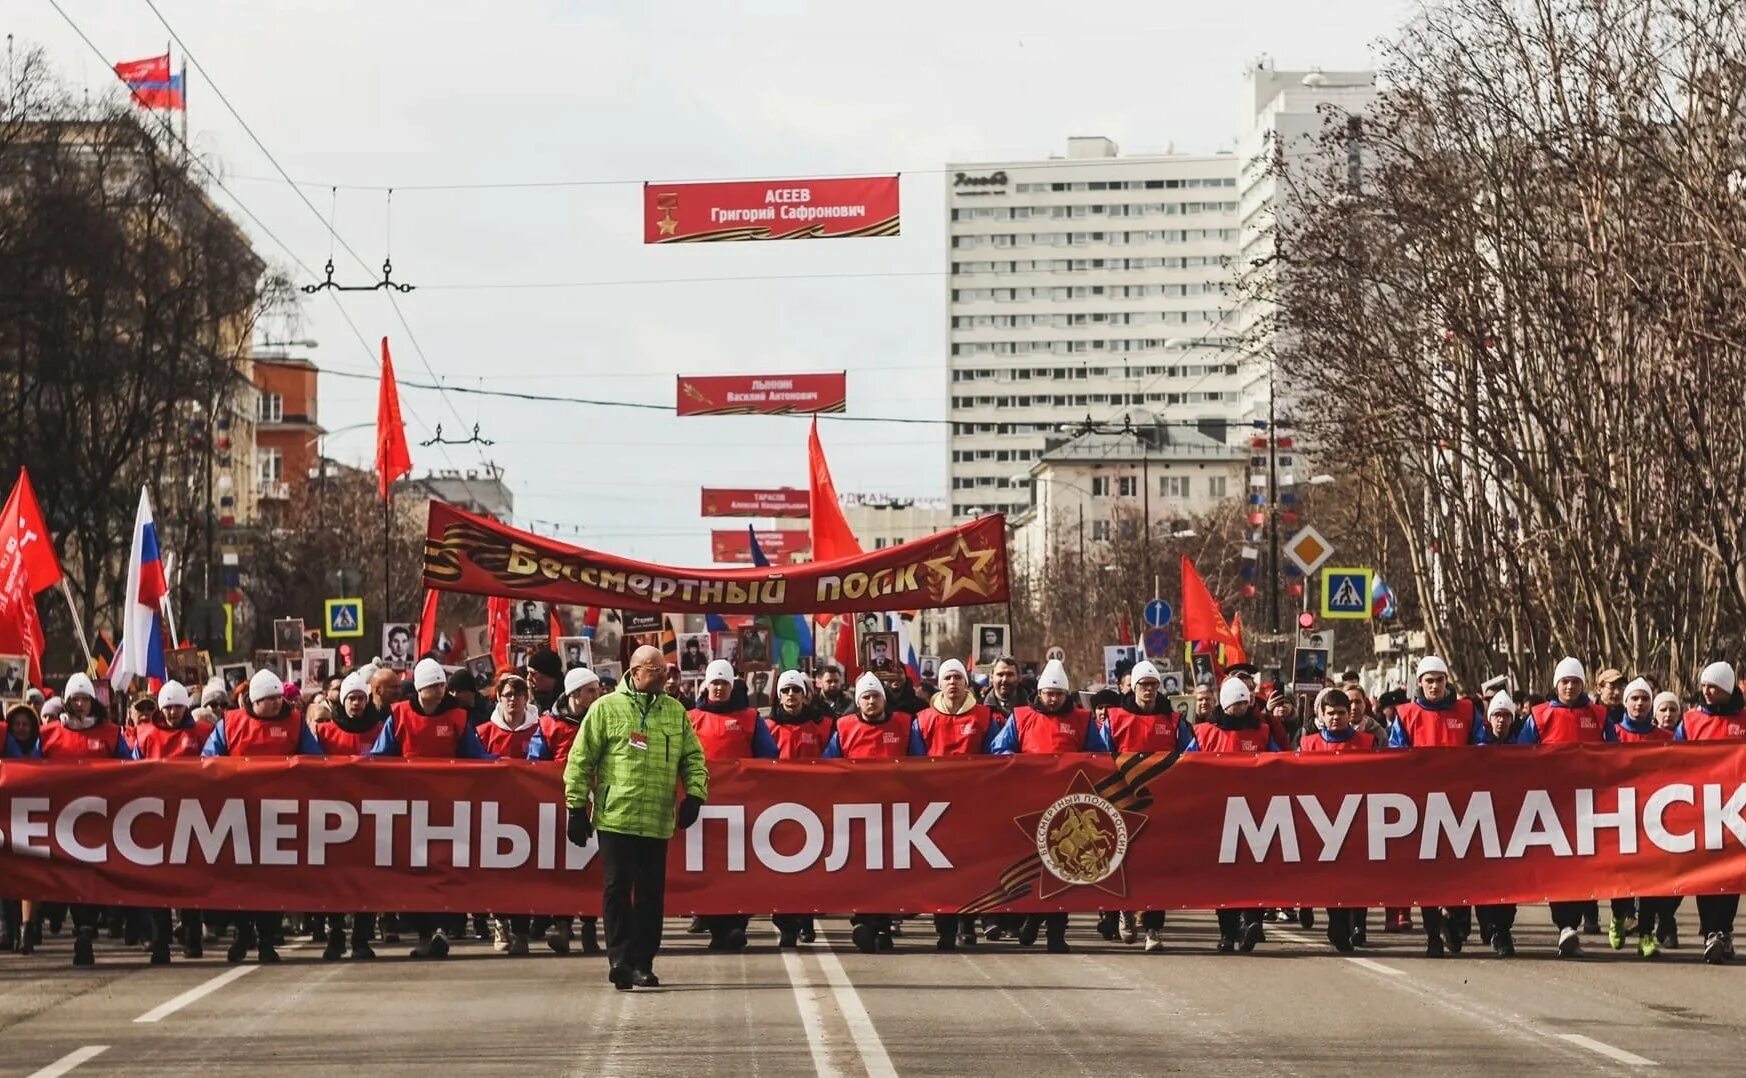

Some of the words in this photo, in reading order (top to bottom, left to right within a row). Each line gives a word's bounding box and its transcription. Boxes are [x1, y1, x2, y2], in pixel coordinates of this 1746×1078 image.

[764, 188, 811, 203] АСЕЕВ
[711, 206, 775, 223] Григорий
[780, 203, 865, 220] Сафронович
[727, 391, 766, 402] Василий
[769, 391, 818, 401] Антонович
[839, 493, 889, 504] ДИАН
[507, 543, 787, 605] Бессмертный
[0, 796, 599, 870] ЕССМЕРТНЫ
[684, 802, 954, 873] ПОЛК
[1218, 783, 1746, 864] МУРМАНСК
[1038, 795, 1082, 856] БЕССМЕРТНЫЙ
[1083, 795, 1113, 812] ПОЛК
[1111, 813, 1127, 856] РОССИИ
